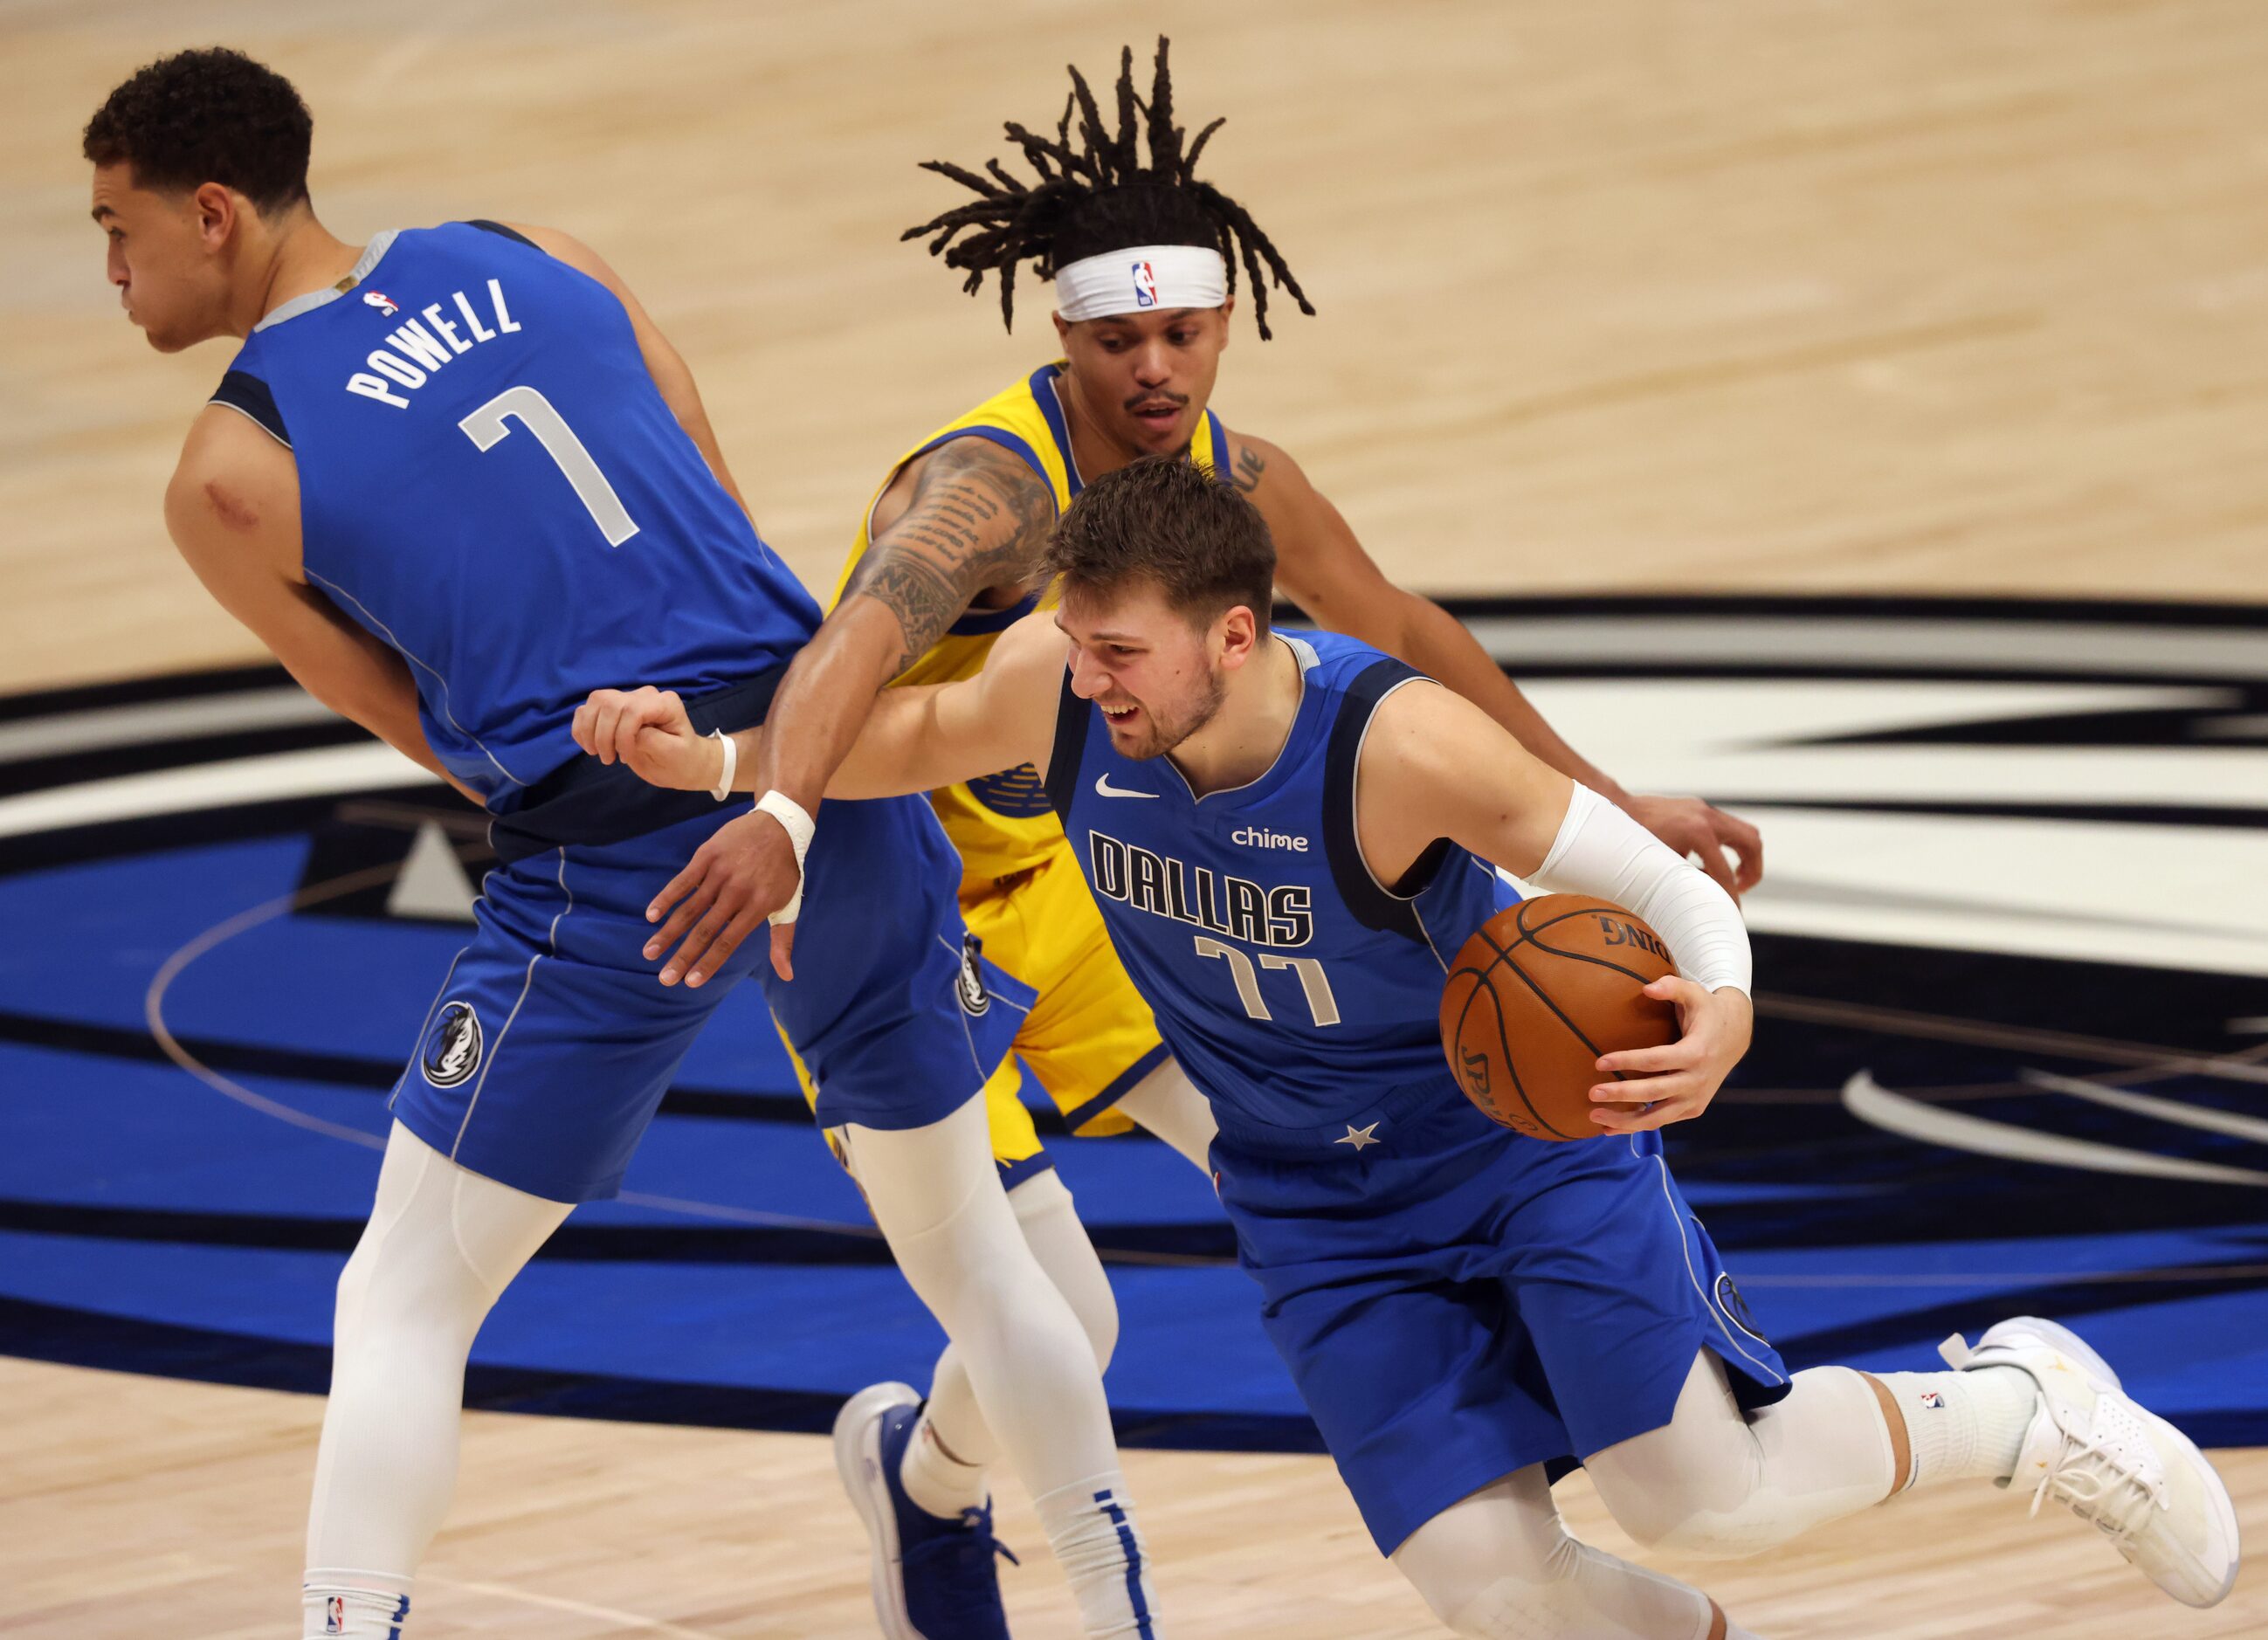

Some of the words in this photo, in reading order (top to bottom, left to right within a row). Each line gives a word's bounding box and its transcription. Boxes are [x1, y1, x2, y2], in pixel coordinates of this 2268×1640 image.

[345, 279, 522, 410] POWELL
[458, 385, 641, 548] 7
[1089, 829, 1313, 947] DALLAS
[1231, 826, 1309, 852] chime
[1194, 935, 1341, 1027] 77
[1598, 915, 1672, 966] DING
